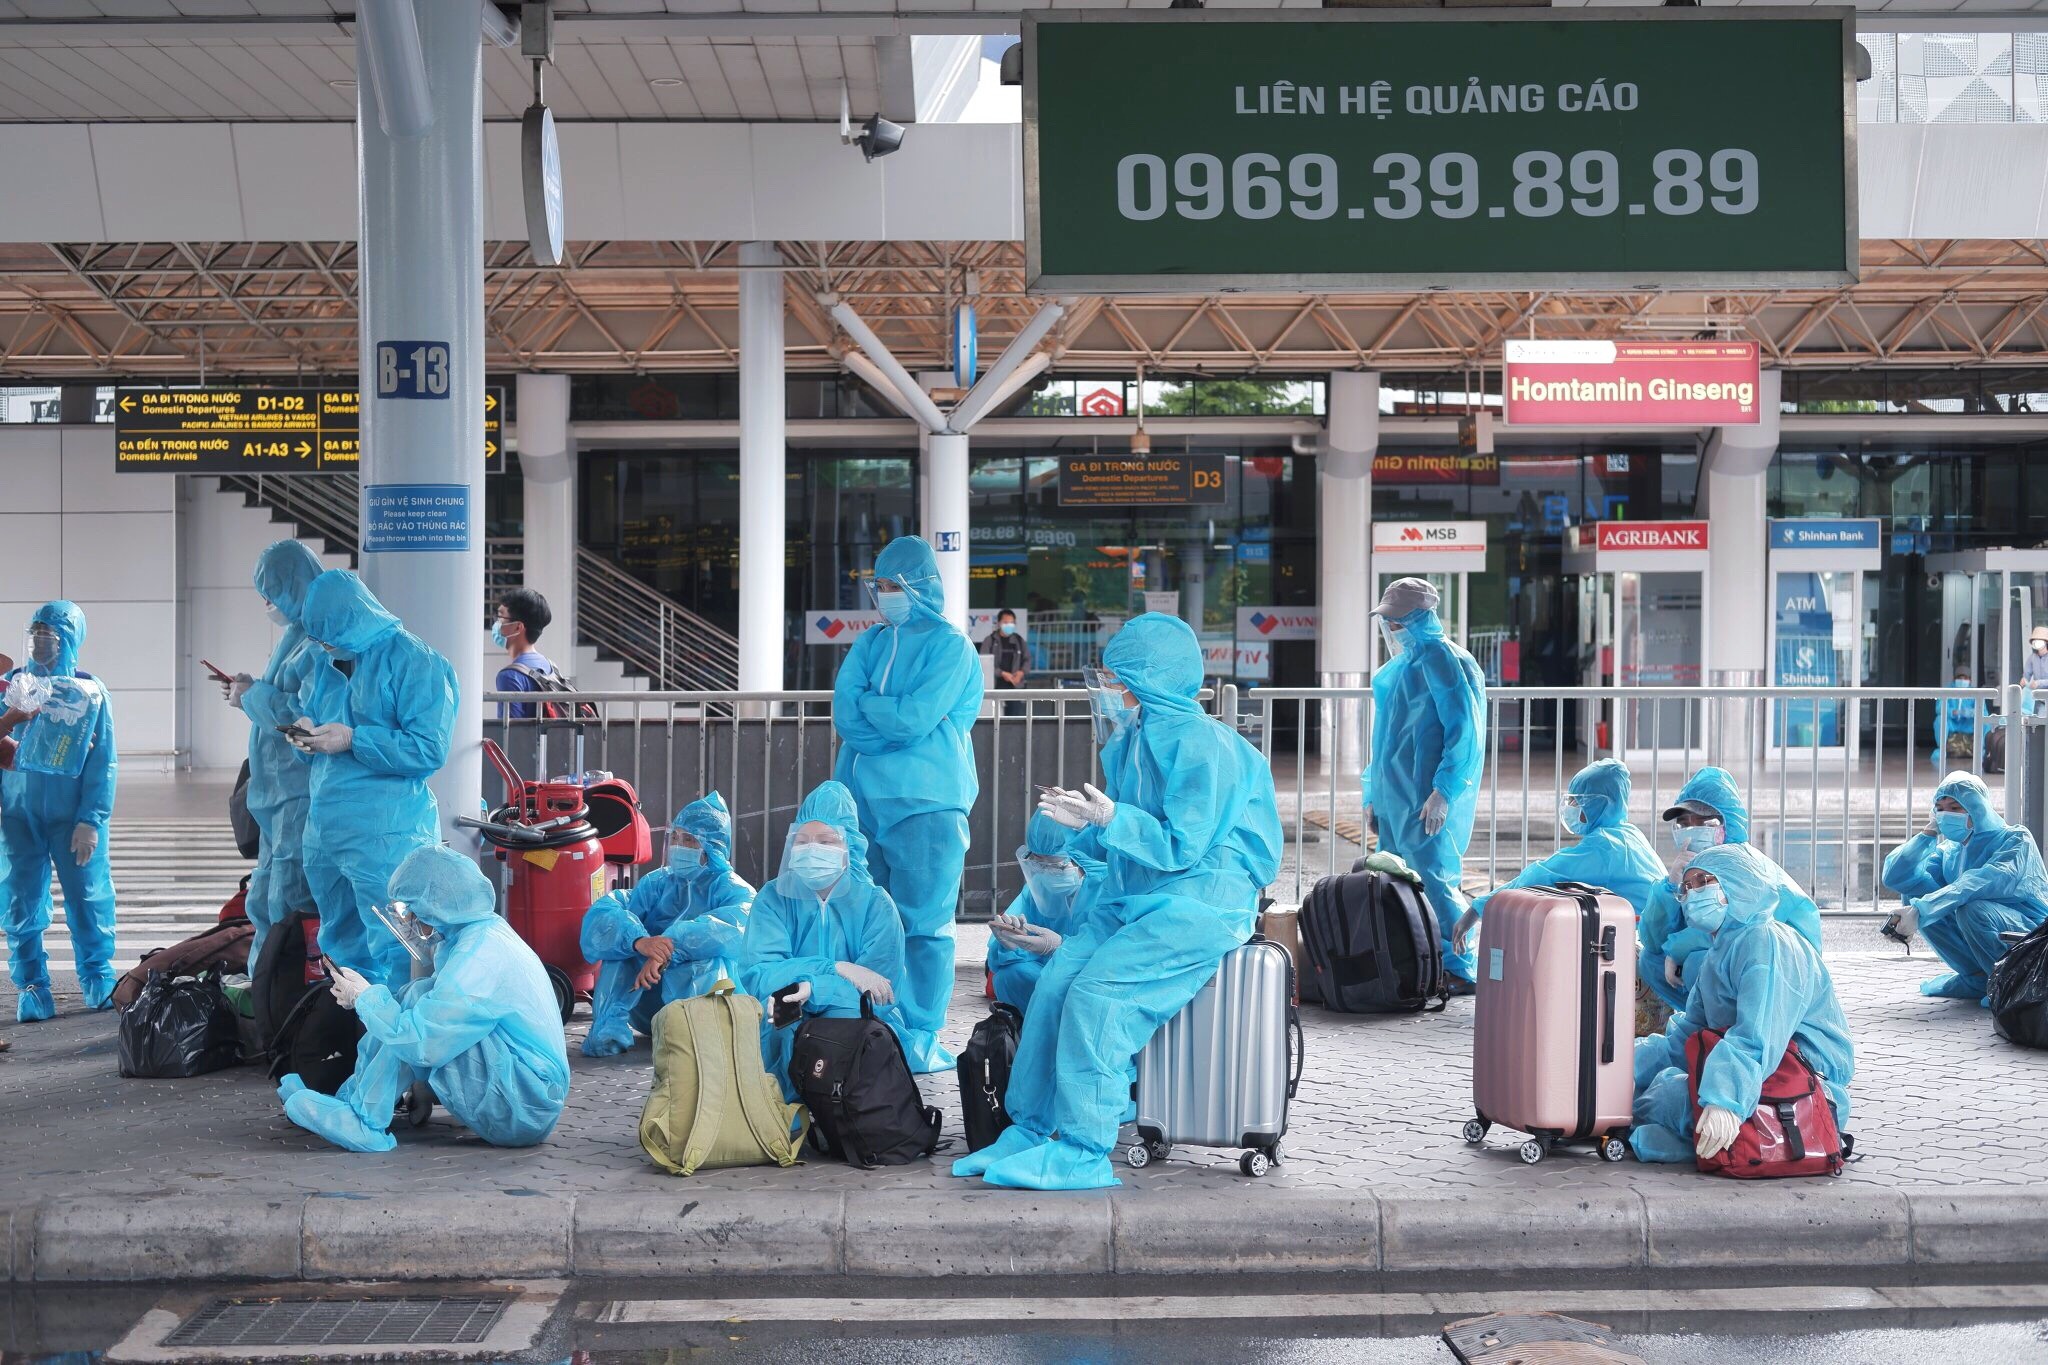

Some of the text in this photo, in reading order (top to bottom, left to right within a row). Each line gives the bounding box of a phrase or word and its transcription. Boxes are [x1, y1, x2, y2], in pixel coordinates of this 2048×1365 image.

[1234, 76, 1639, 120] LIÊN HỆ QUẢNG CÁO
[1116, 148, 1759, 221] 0969.39.89.89
[379, 346, 448, 395] B-13
[1511, 376, 1753, 405] Homtamin Ginseng
[142, 394, 158, 404] GA
[173, 394, 209, 404] TRONG
[323, 393, 340, 403] GA
[257, 396, 304, 411] D1-D2
[142, 405, 236, 415] Domestic Departures
[218, 413, 250, 421] VIETNAM
[251, 413, 283, 421] AIRLINES
[181, 421, 210, 429] PACIFIC
[210, 421, 243, 429] AIRLINES
[119, 440, 135, 450] GA
[161, 440, 197, 450] TRONG
[242, 443, 289, 457] A1-A3
[323, 440, 340, 450] GA
[119, 452, 198, 461] Domestic Arrivals
[1069, 462, 1087, 472] GA
[1104, 462, 1145, 472] TRONG
[1082, 474, 1169, 484] Domestic Departures
[1193, 470, 1221, 488] D3
[411, 497, 433, 506] SINH
[435, 497, 465, 506] CHUNG
[383, 510, 406, 518] Please
[407, 510, 426, 519] keep
[407, 534, 427, 542] trash
[428, 534, 443, 542] into
[444, 534, 455, 542] the
[456, 534, 467, 542] bin
[1426, 528, 1457, 540] MSB
[1602, 530, 1700, 546] AGRIBANK
[1798, 530, 1864, 541] Shinhan Bank
[936, 532, 960, 551] A-14
[1785, 597, 1816, 611] ATM
[1782, 672, 1829, 684] Shinhan
